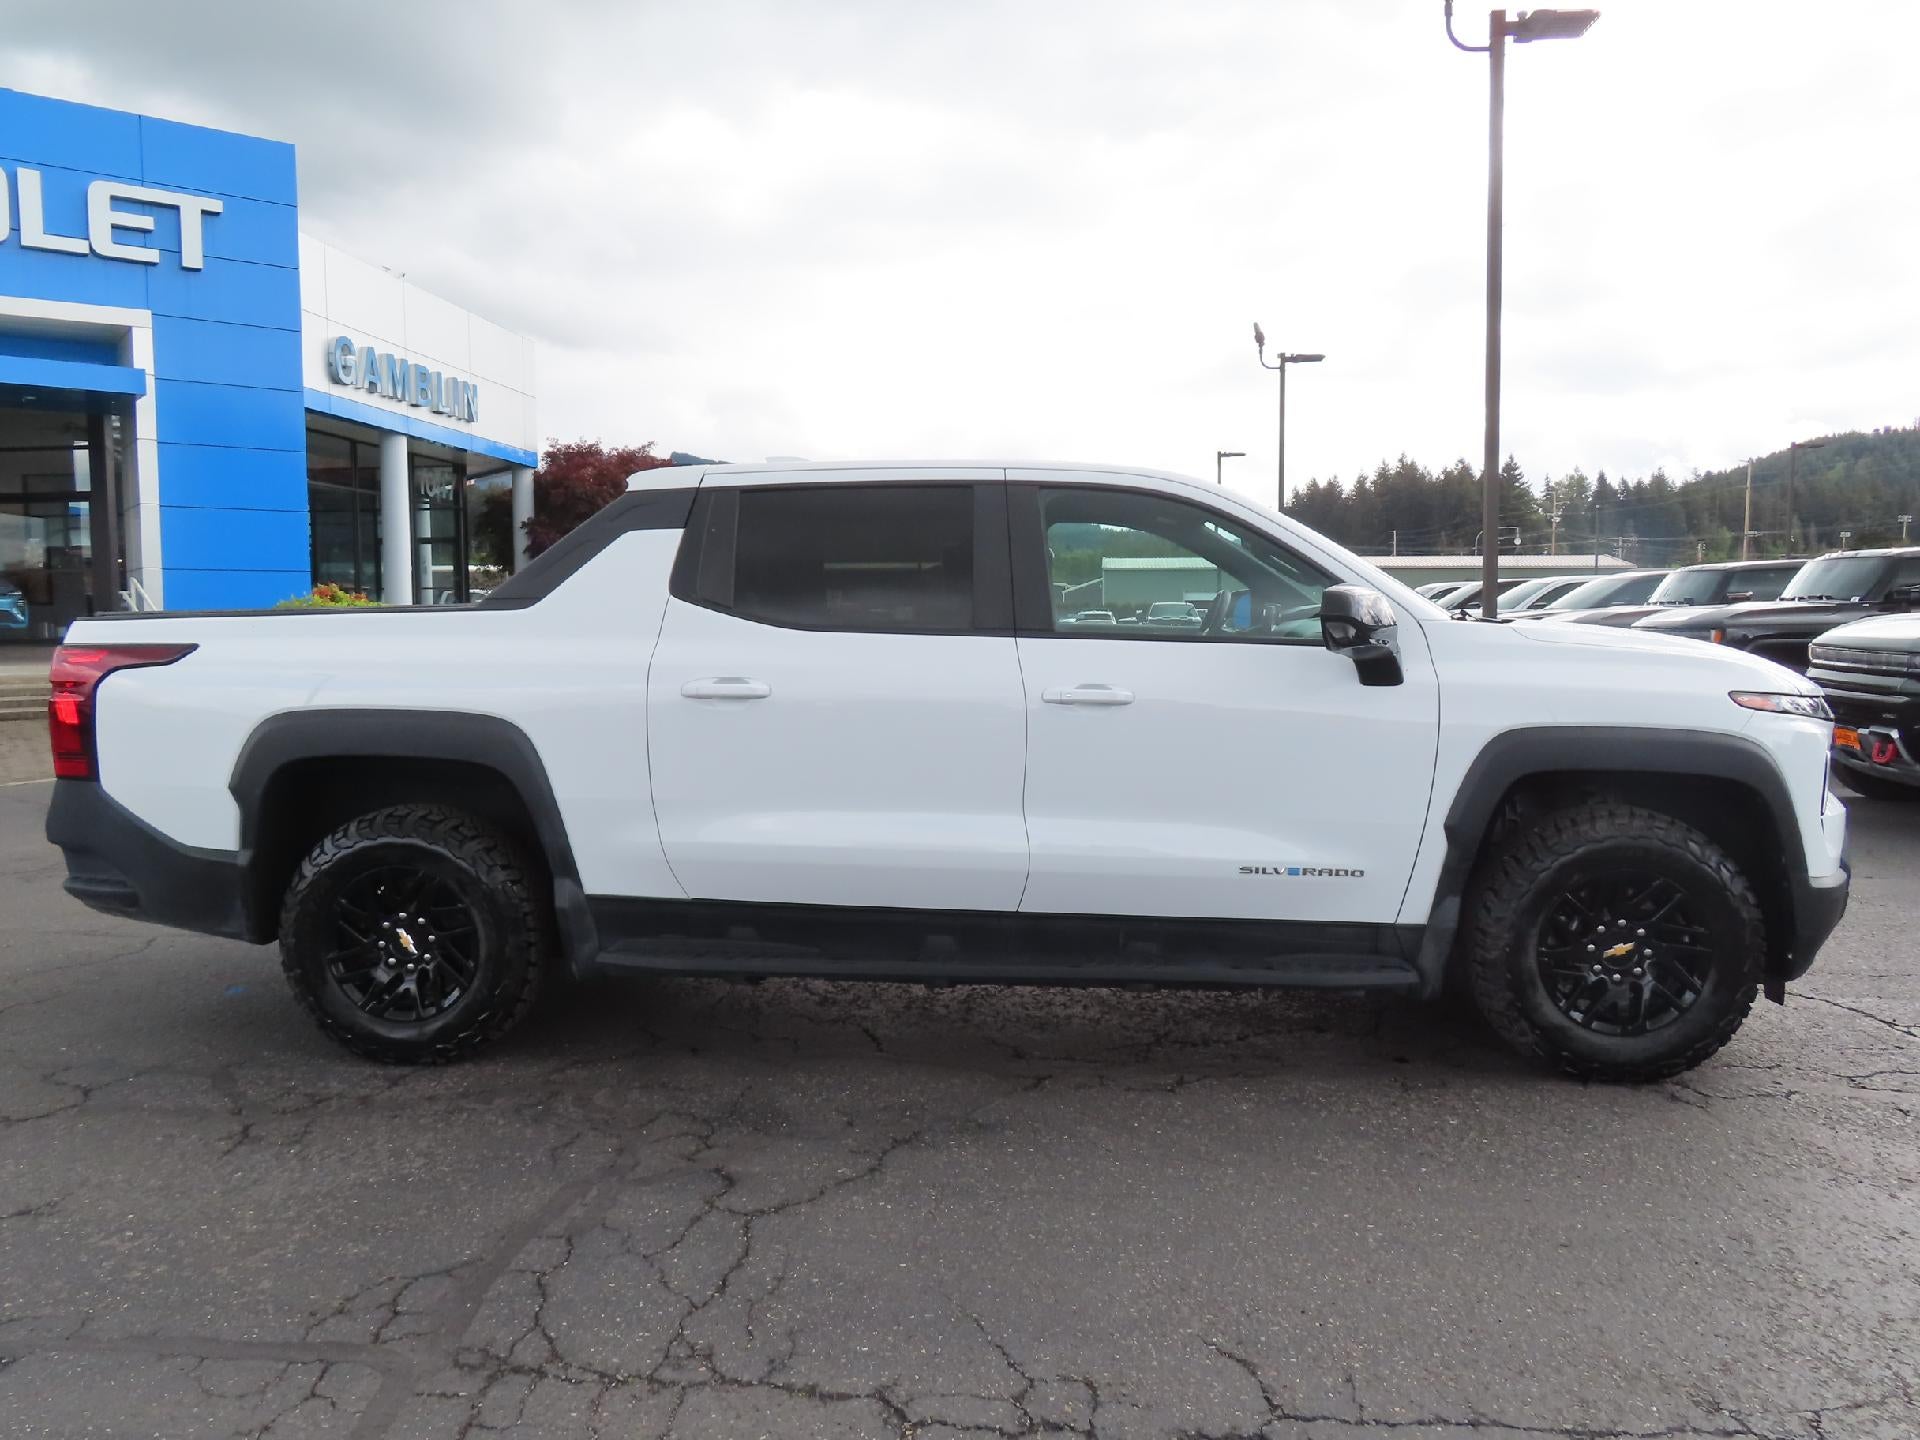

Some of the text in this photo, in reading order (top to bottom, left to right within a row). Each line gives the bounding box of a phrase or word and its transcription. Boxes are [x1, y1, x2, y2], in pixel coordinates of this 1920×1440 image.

[0, 166, 223, 271] LET
[328, 335, 479, 423] GAMBLIN
[1238, 865, 1365, 878] SILVERADO
